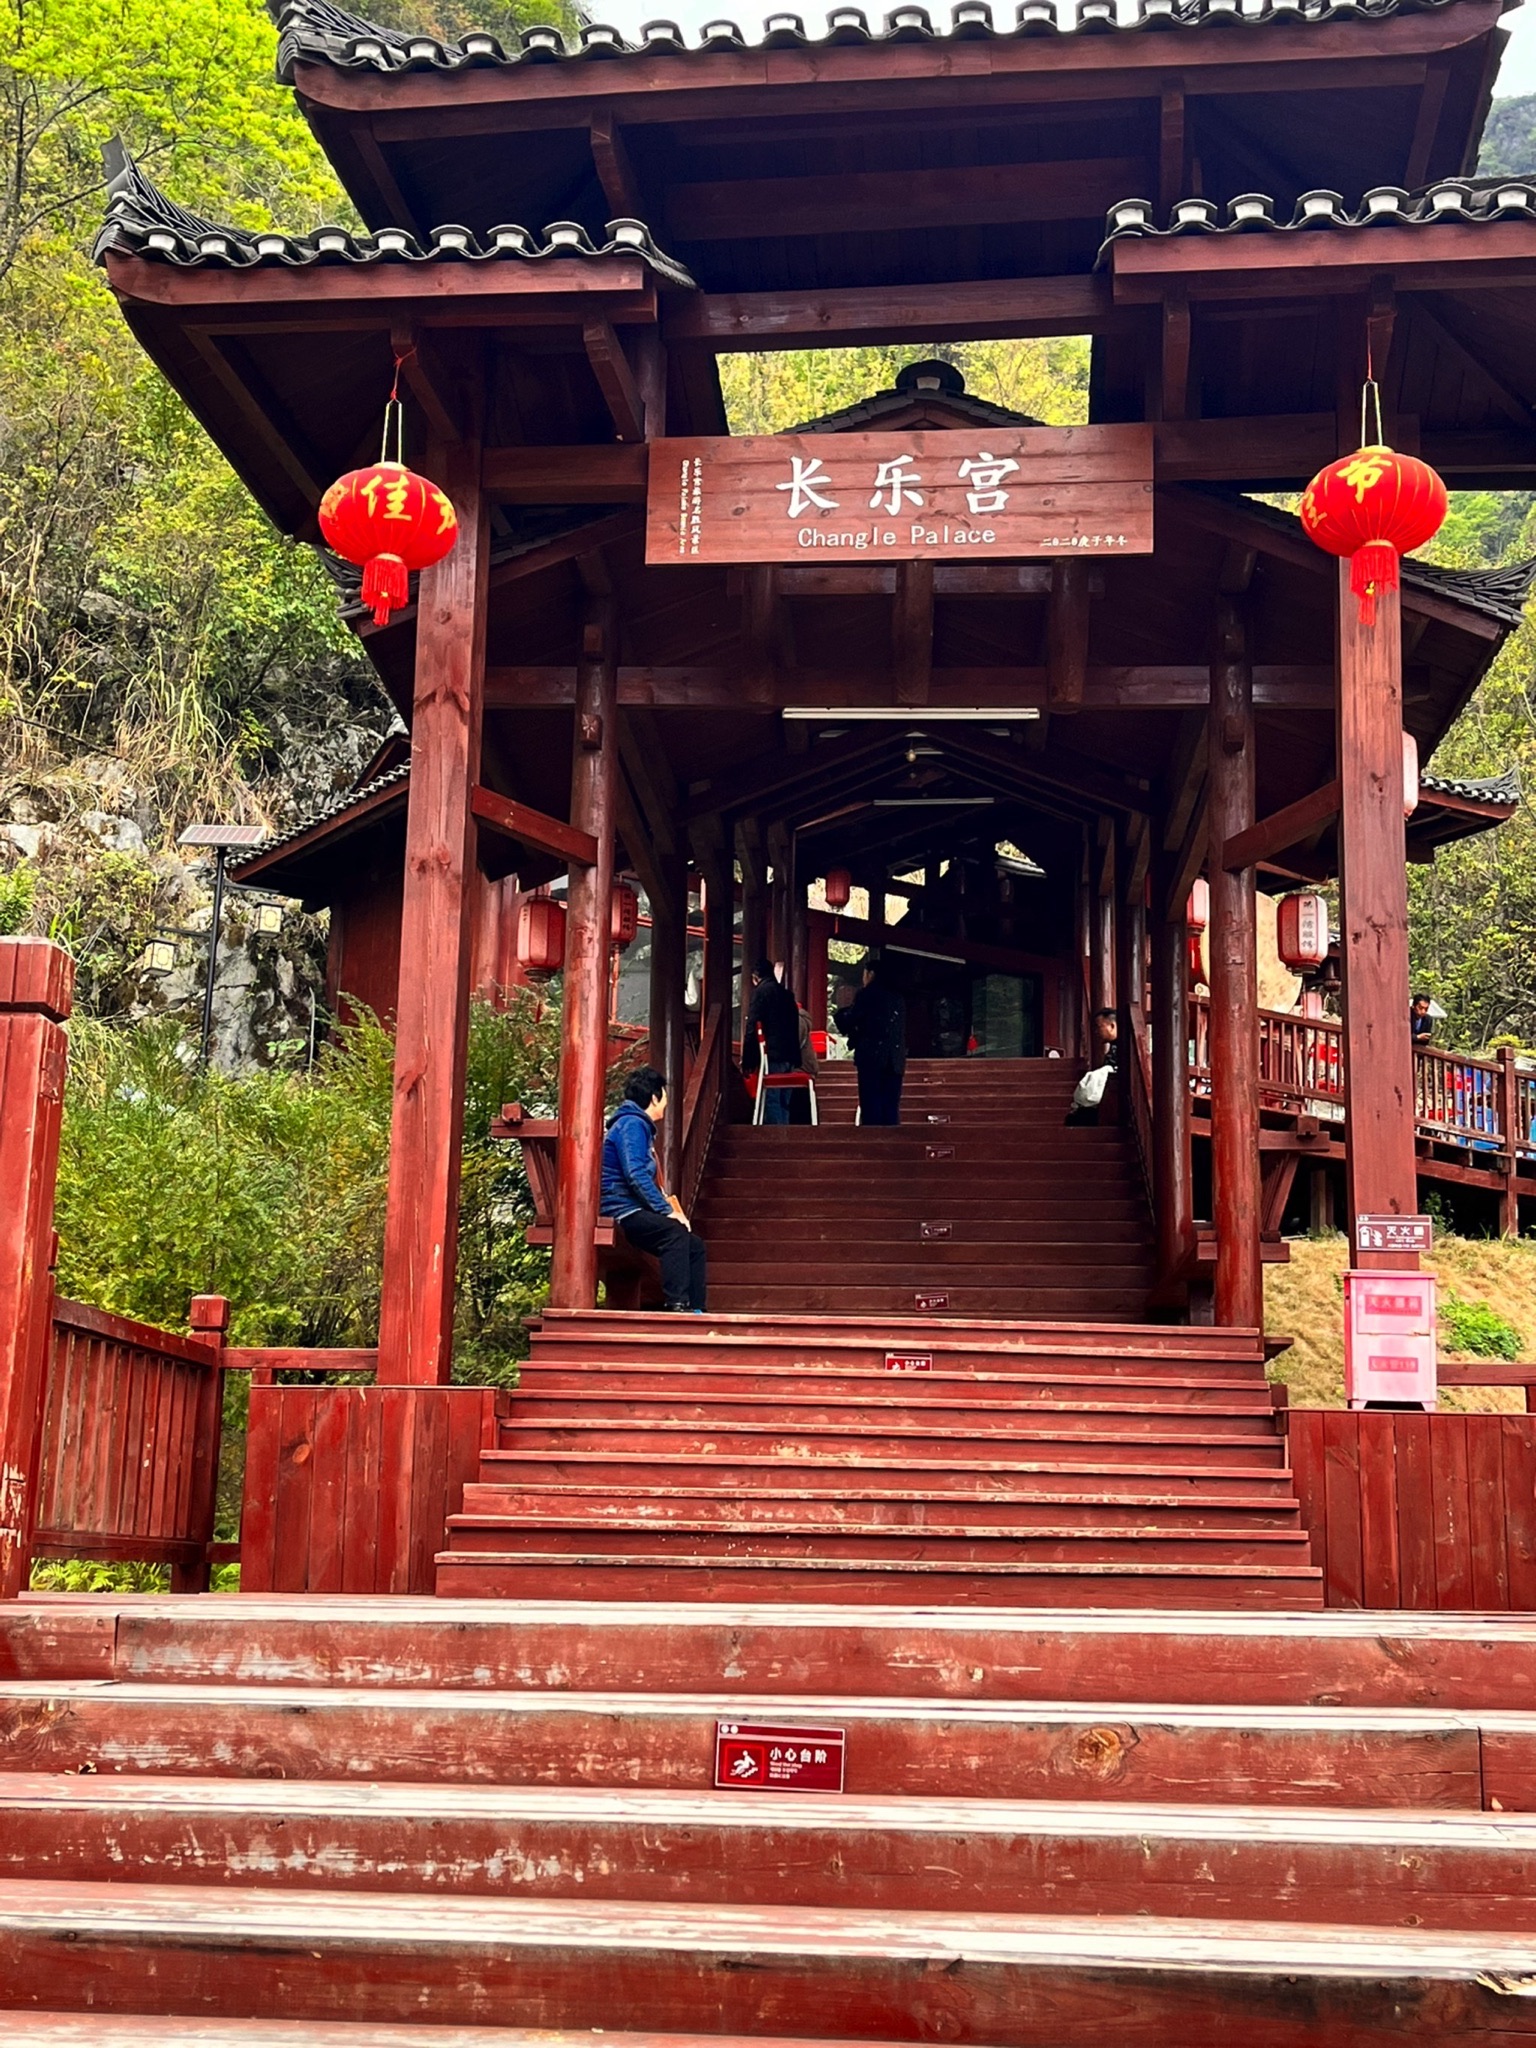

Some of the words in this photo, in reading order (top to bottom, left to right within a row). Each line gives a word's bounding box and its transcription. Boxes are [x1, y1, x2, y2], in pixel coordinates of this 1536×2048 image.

[360, 473, 413, 522] 佳
[774, 452, 1020, 518] 长乐宫
[798, 527, 897, 550] Changle
[911, 525, 996, 545] Palace
[769, 1747, 827, 1764] 小心台阶
